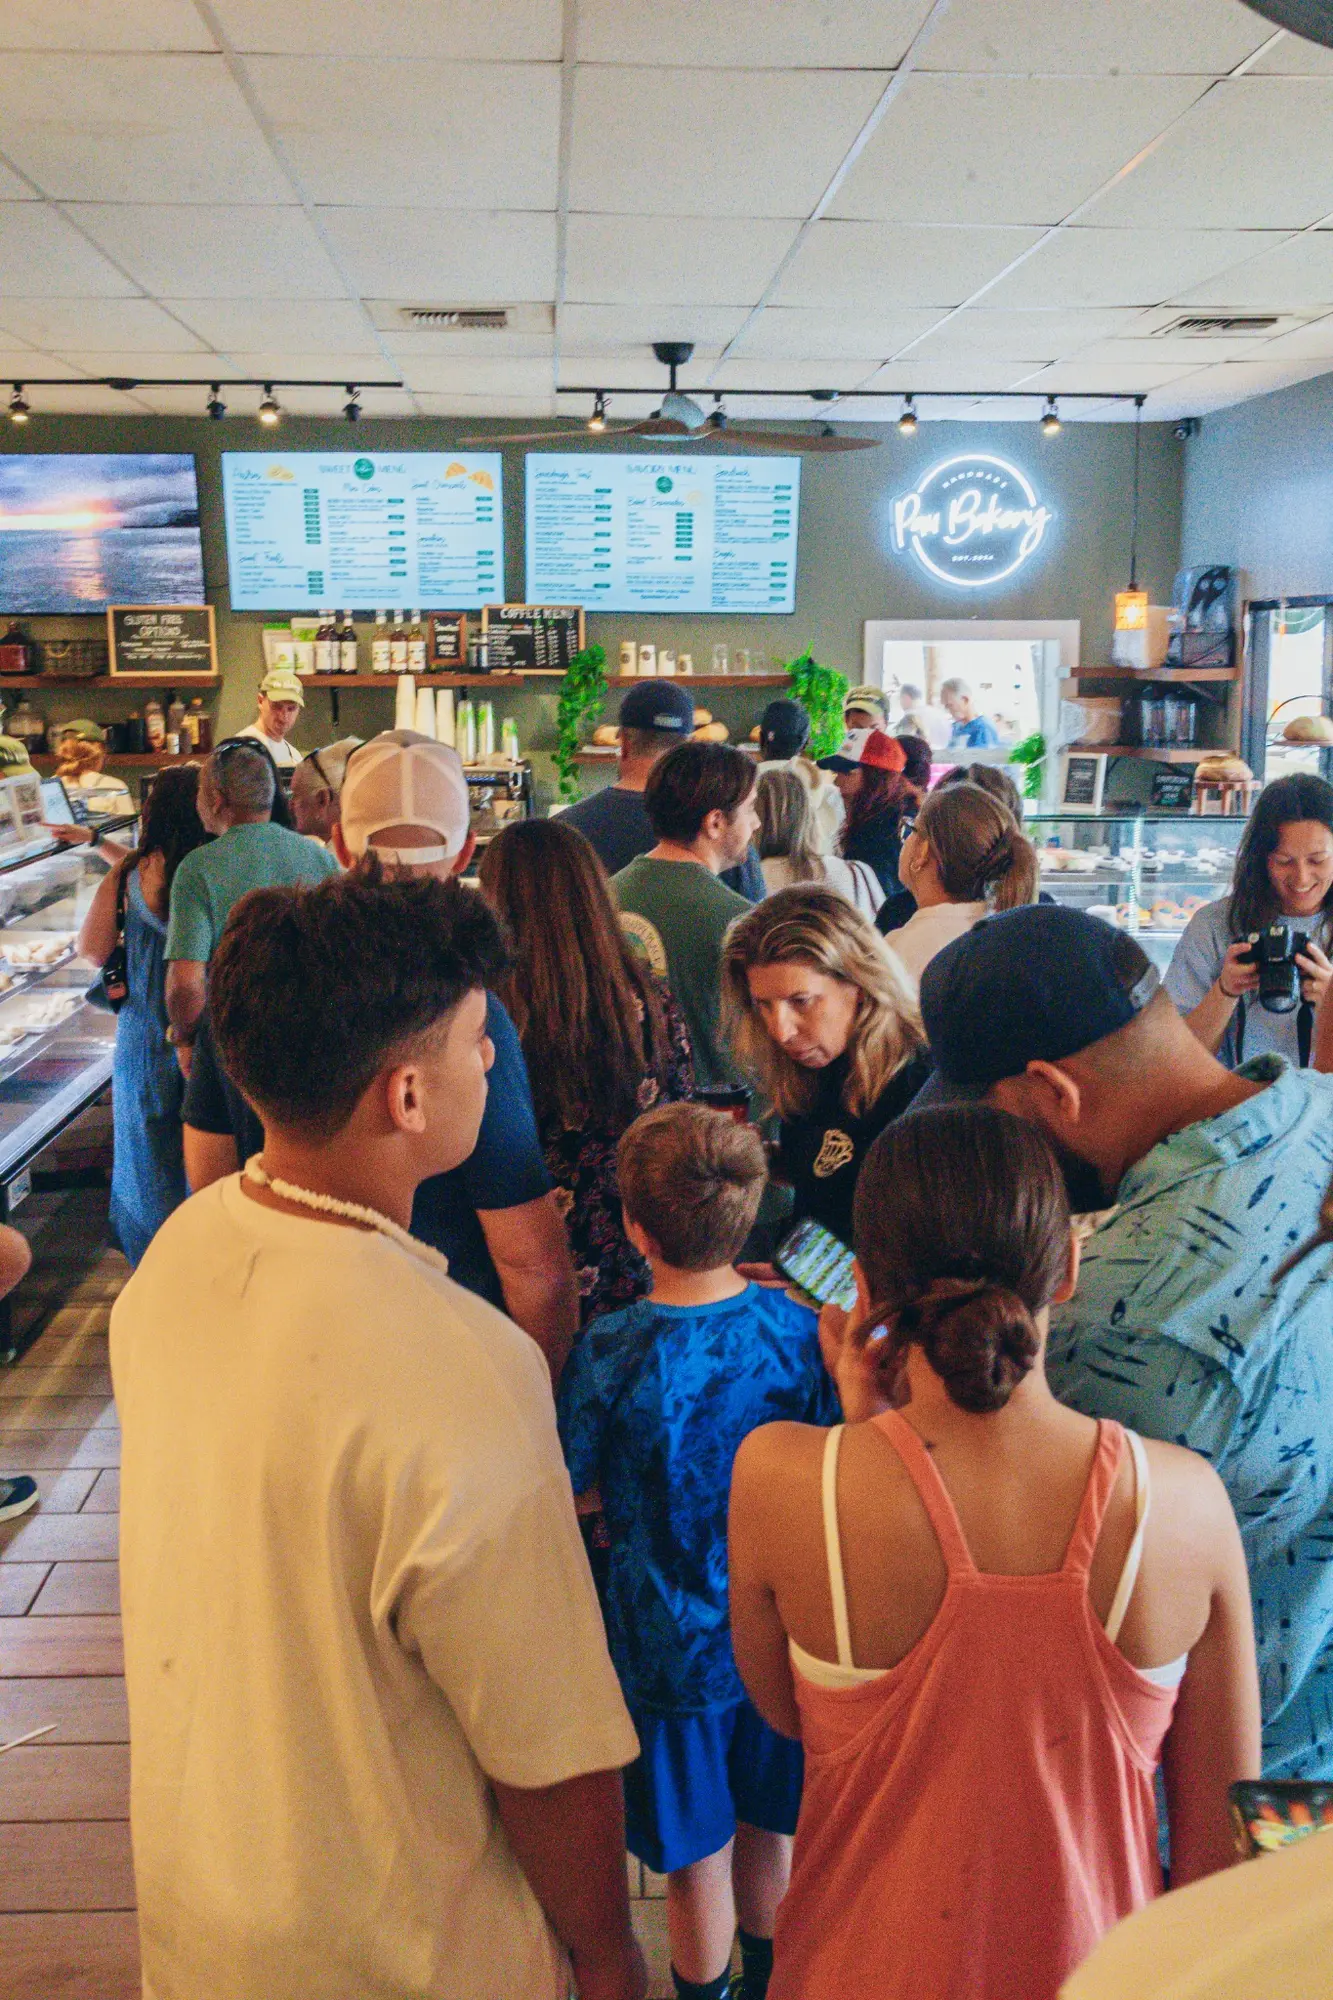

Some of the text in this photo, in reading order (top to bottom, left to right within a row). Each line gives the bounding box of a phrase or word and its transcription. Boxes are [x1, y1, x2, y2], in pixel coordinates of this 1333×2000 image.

[943, 489, 1052, 555] Bakery
[500, 608, 575, 619] COFFEE MENU
[124, 614, 184, 626] GLUTEN FREE
